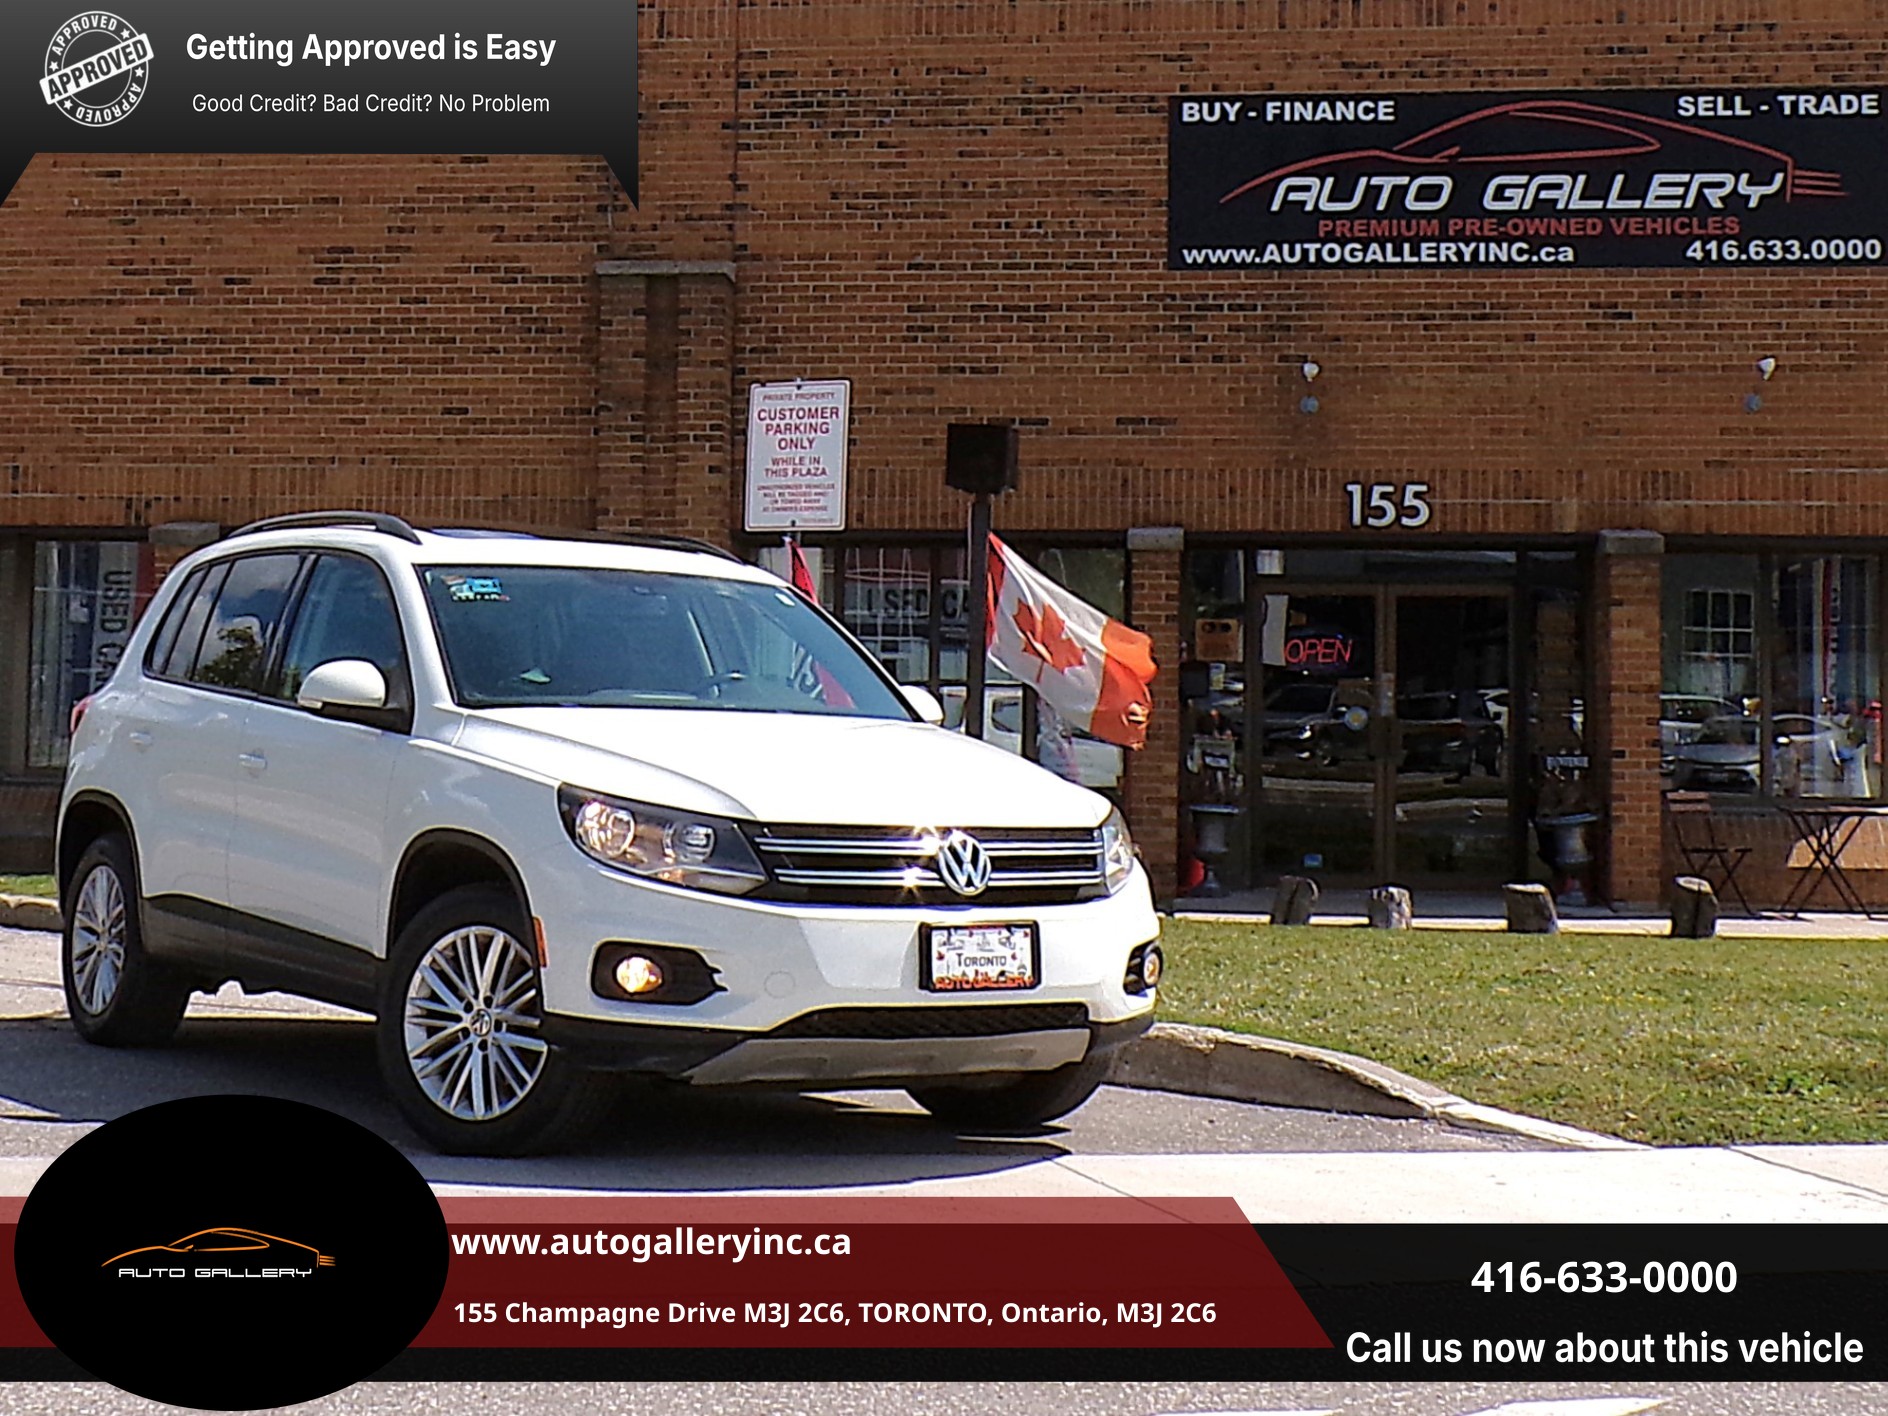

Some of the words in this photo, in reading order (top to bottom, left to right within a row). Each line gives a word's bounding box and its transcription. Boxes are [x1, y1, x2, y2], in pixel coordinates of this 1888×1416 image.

[1182, 101, 1242, 122] BUY
[1266, 100, 1396, 122] FINANCE
[1677, 95, 1752, 117] SELL
[1776, 94, 1880, 116] TRADE
[1270, 176, 1453, 212] AUTO
[1482, 172, 1785, 211] GALLERY
[1318, 219, 1440, 237] PREMIUM
[1448, 217, 1604, 236] PRE-OWNED
[1609, 216, 1741, 234] VEHICLES
[1182, 242, 1575, 265] www.AUTOGALLERYINC.ca
[1685, 239, 1883, 262] 416.633.0000
[757, 406, 840, 422] CUSTOMER
[765, 422, 830, 435] PARKING
[778, 437, 815, 450] ONLY
[771, 456, 805, 466] WHILE
[809, 456, 821, 466] IN
[764, 468, 789, 478] THIS
[792, 467, 827, 477] PLAZA
[1347, 484, 1430, 526] 155
[102, 570, 132, 633] USED
[1284, 637, 1353, 664] OPEN
